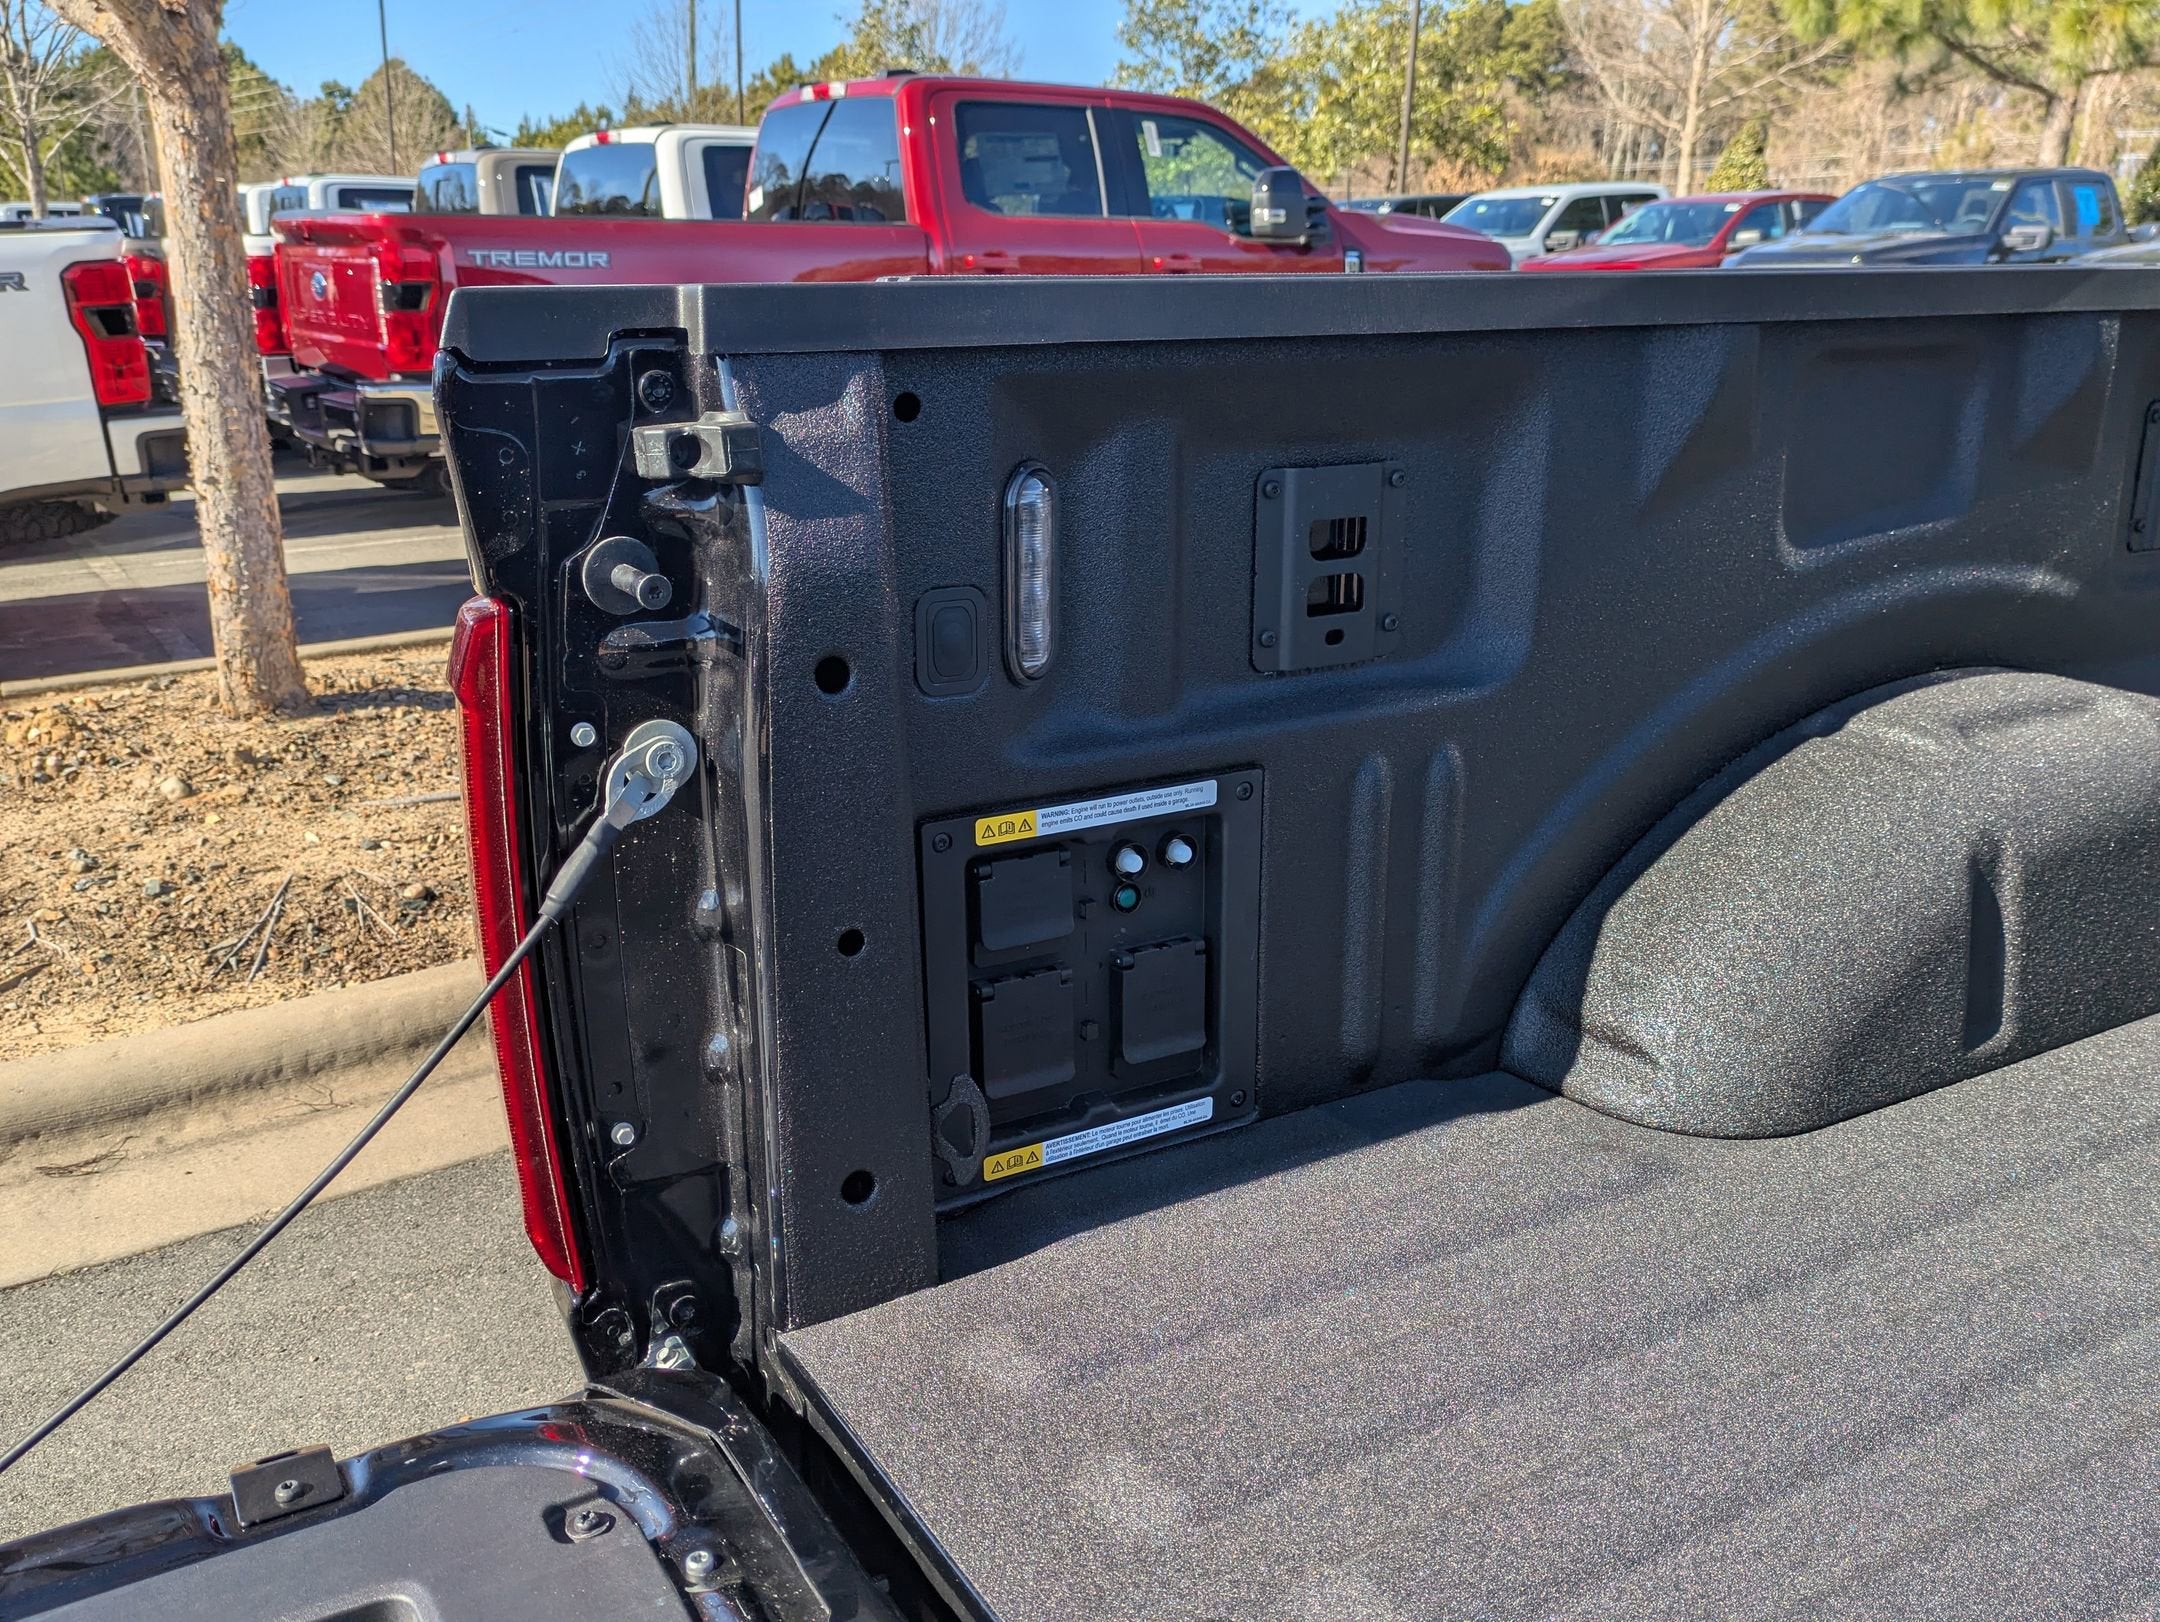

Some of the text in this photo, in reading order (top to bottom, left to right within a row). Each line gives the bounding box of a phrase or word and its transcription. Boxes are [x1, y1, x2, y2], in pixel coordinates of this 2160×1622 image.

[467, 249, 609, 267] TREMOR
[1041, 809, 1070, 819] WARNING:
[1113, 800, 1127, 808] power
[1184, 786, 1203, 794] Running
[1041, 820, 1059, 828] engine
[1123, 805, 1137, 813] death
[1154, 799, 1167, 807] inside
[1172, 797, 1188, 805] garage.
[1046, 1132, 1091, 1150] AVERTISSEMENT:
[1116, 1122, 1131, 1130] tourne
[1131, 1118, 1142, 1126] pour
[1143, 1113, 1162, 1122] alimenter
[1170, 1108, 1183, 1116] prises.
[1185, 1101, 1205, 1110] Utilisation
[1050, 1145, 1073, 1155] l'extérieur
[1073, 1138, 1098, 1148] seulement.
[1101, 1131, 1117, 1140] Quand
[1139, 1122, 1153, 1130] tourne,
[1046, 1152, 1068, 1162] utilisation
[1073, 1145, 1094, 1154] l'intérieur
[1095, 1141, 1105, 1149] d'un
[1106, 1138, 1121, 1147] garage
[1122, 1134, 1132, 1142] peut
